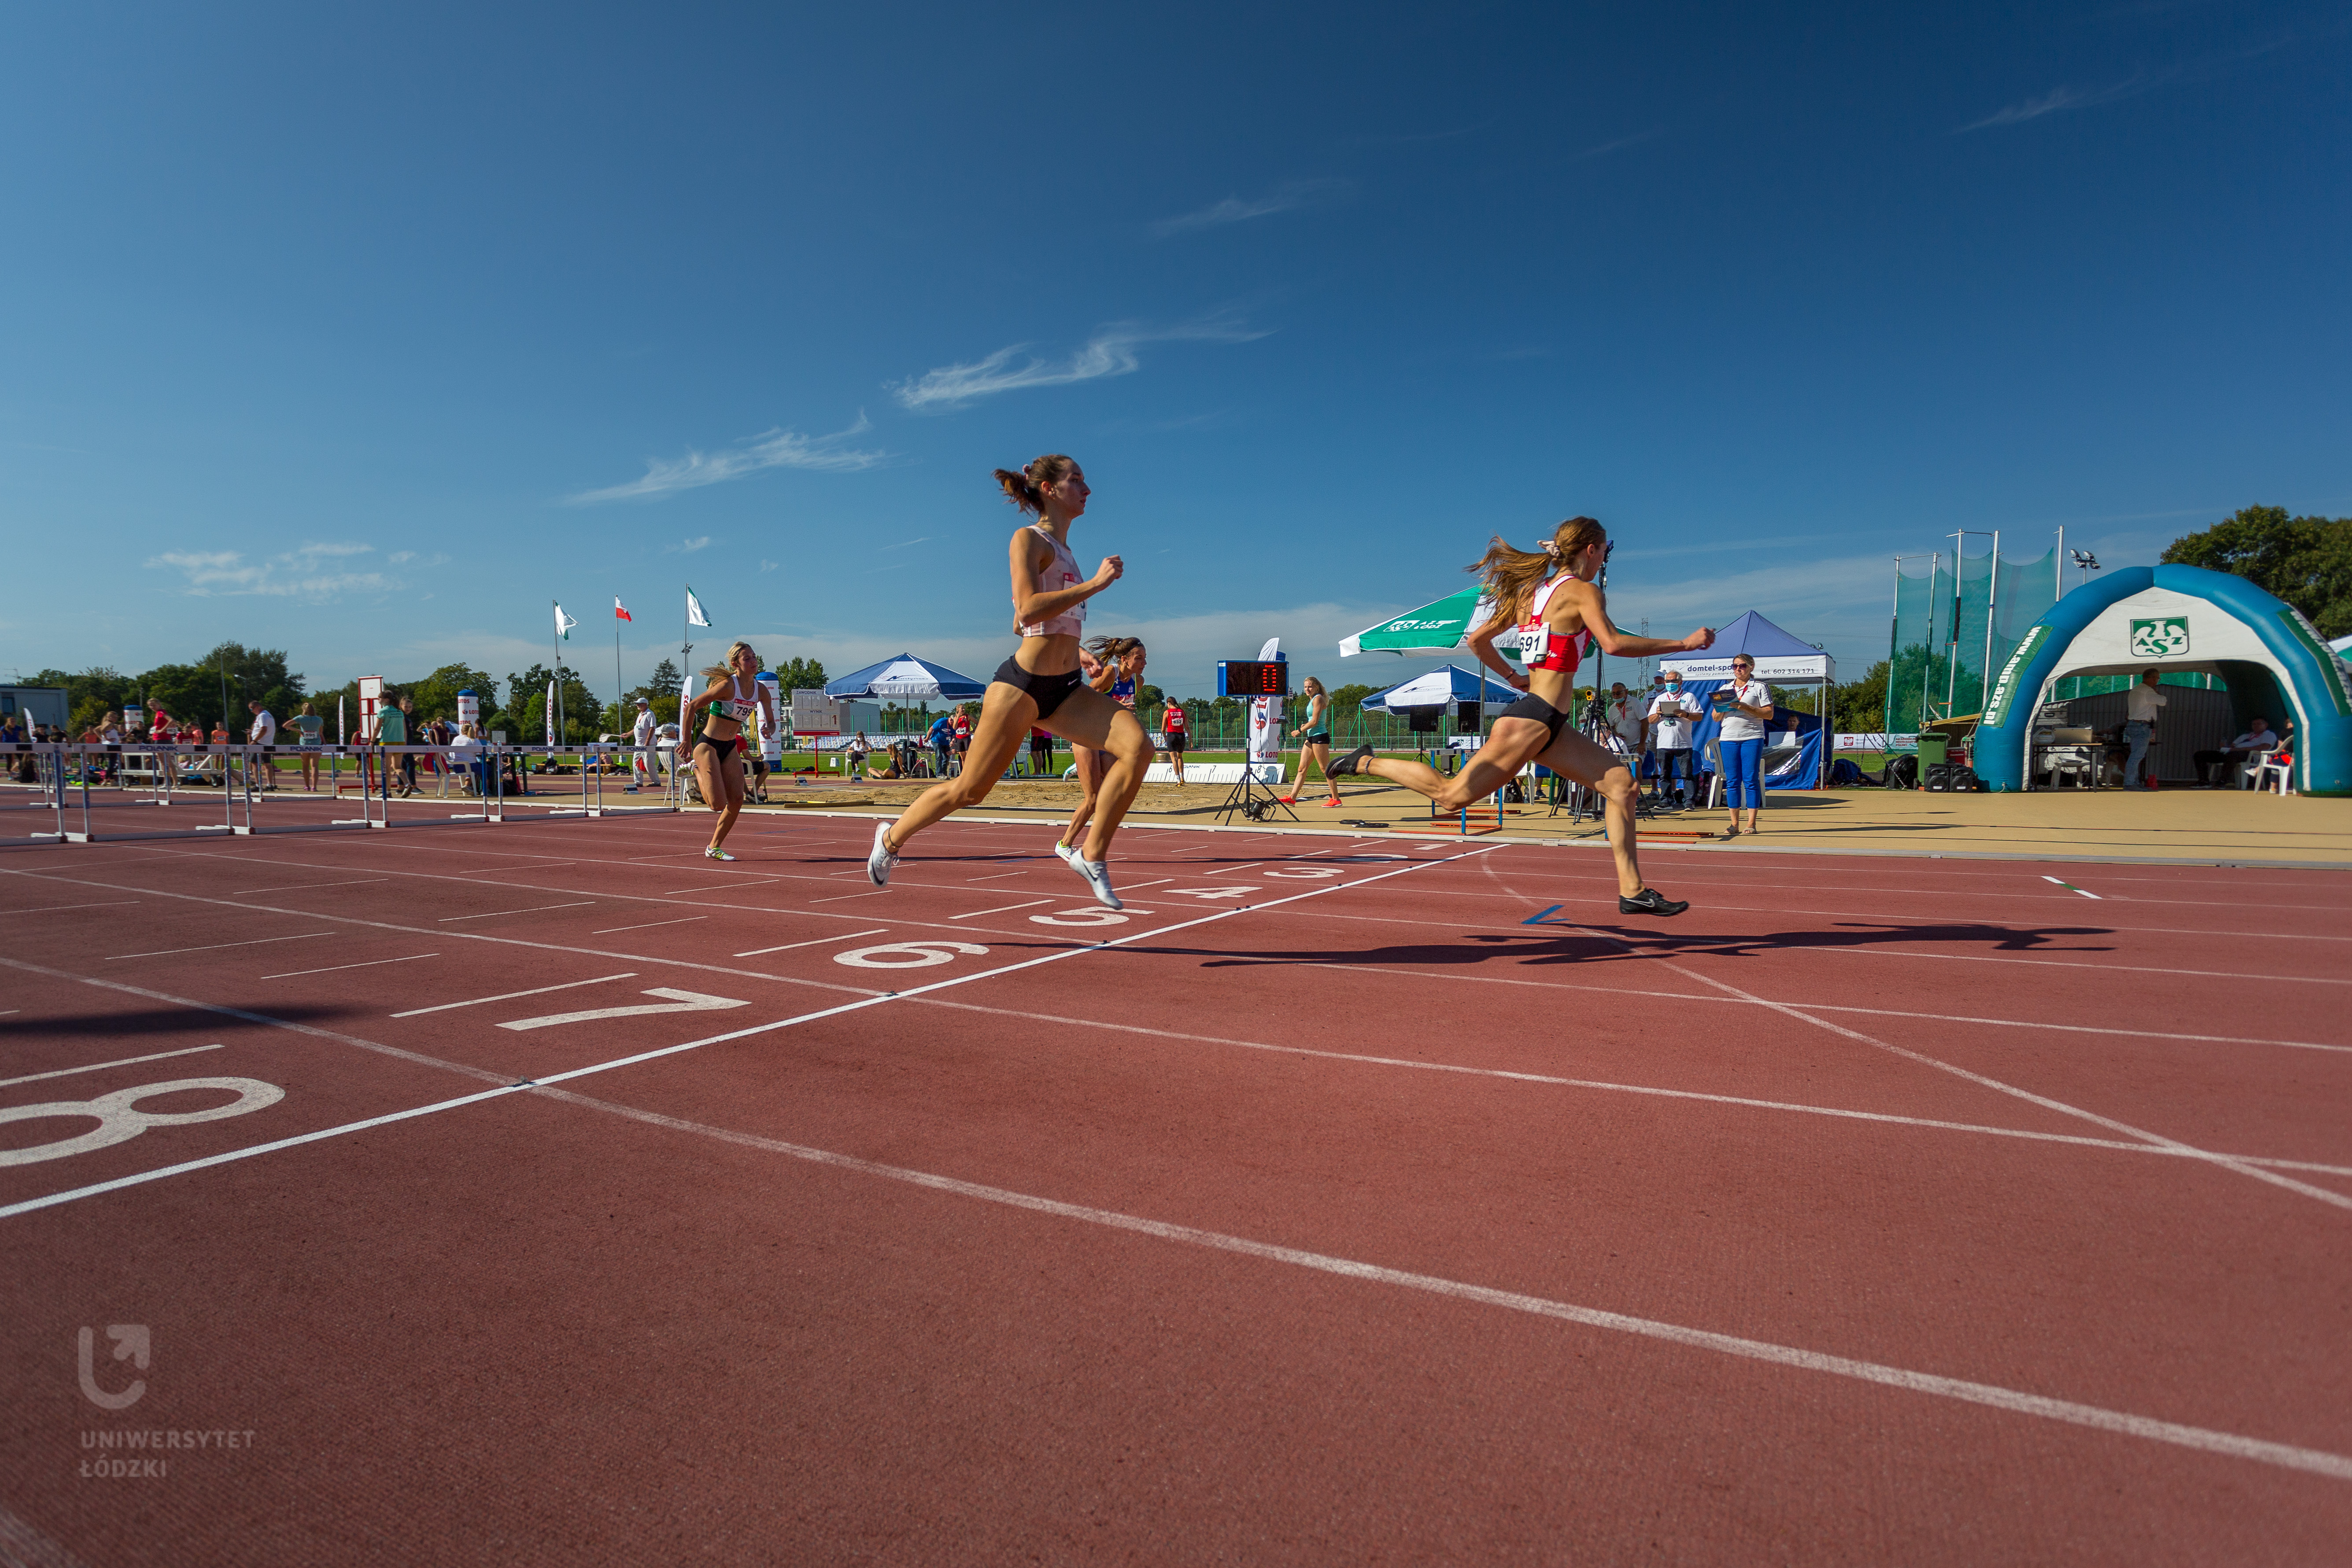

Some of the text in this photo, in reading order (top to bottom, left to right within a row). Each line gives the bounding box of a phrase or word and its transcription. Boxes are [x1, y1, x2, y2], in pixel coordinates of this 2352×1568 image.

[1519, 635, 1540, 653] 691
[1263, 665, 1276, 691] 0
[1983, 627, 2042, 725] www.amp.azs.pl
[736, 706, 753, 716] 799
[832, 715, 837, 725] 1
[1263, 867, 1345, 878] 3
[1161, 886, 1263, 899] 4
[1029, 906, 1156, 926] 5
[833, 941, 990, 969] 6
[495, 987, 752, 1031] 7
[0, 1077, 286, 1167] 8
